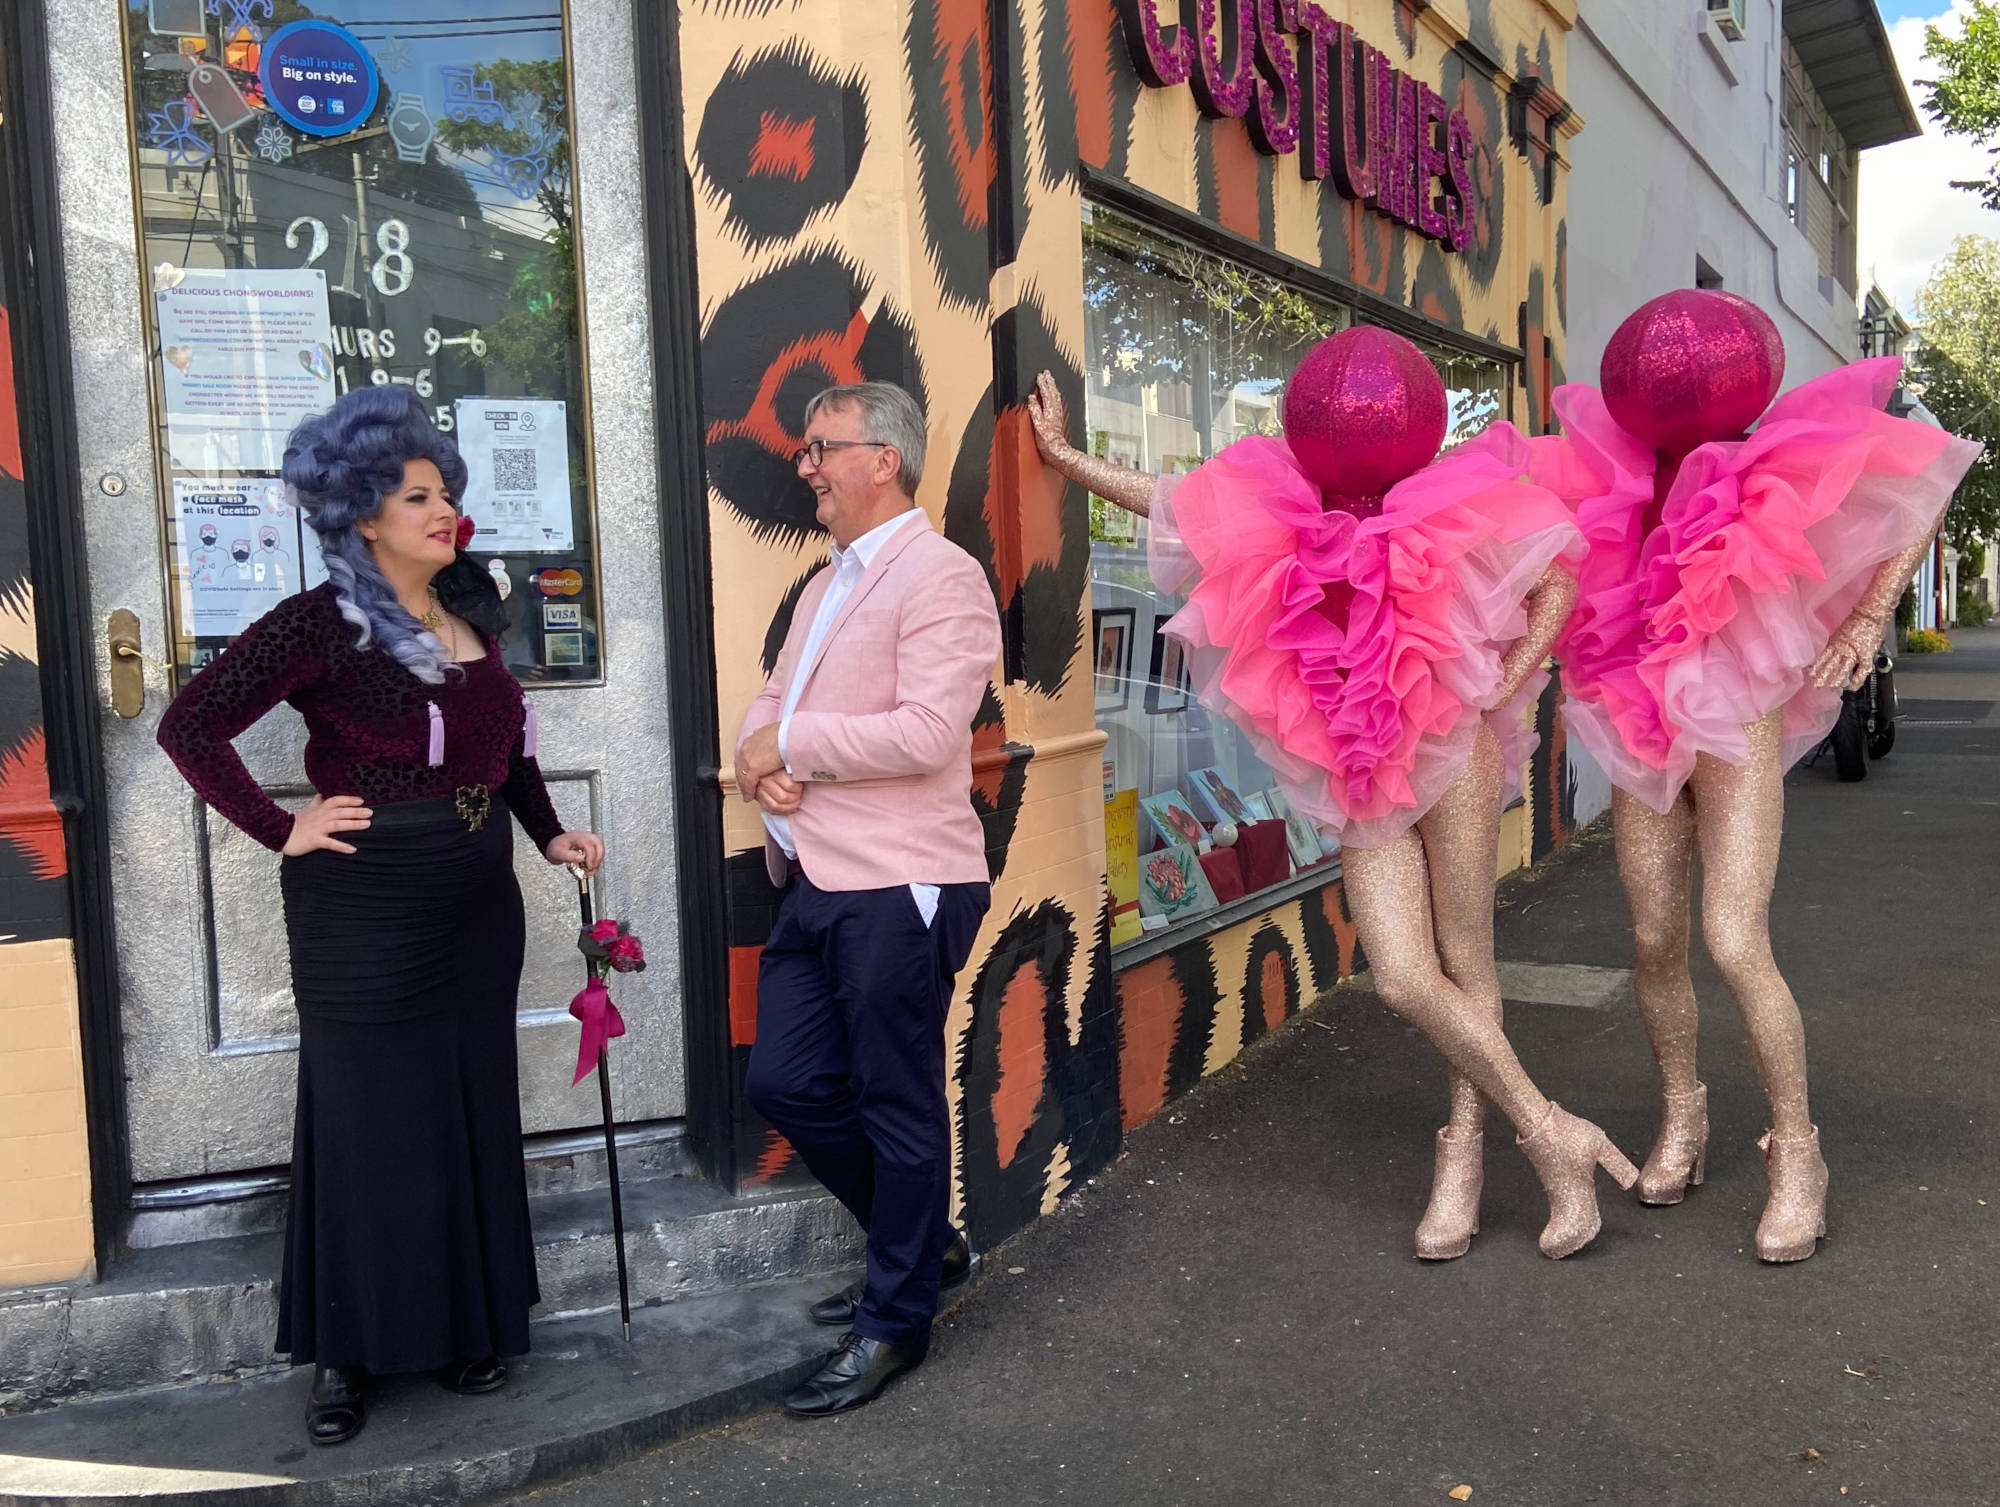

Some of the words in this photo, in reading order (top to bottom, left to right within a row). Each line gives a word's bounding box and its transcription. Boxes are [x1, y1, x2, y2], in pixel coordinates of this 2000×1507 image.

[280, 55, 313, 68] Small
[317, 57, 328, 68] in
[331, 60, 358, 71] size.
[282, 67, 303, 81] Big
[306, 71, 321, 80] on
[324, 71, 357, 84] style.
[286, 214, 414, 299] 218
[171, 287, 221, 296] DELICIOUS
[223, 289, 314, 298] CHONGWORLDIANS!
[424, 327, 487, 357] 9-6
[193, 495, 217, 504] face
[218, 495, 245, 503] mask
[197, 506, 214, 514] this
[219, 506, 260, 516] location
[539, 578, 582, 587] MasterCard
[550, 609, 577, 620] VISA
